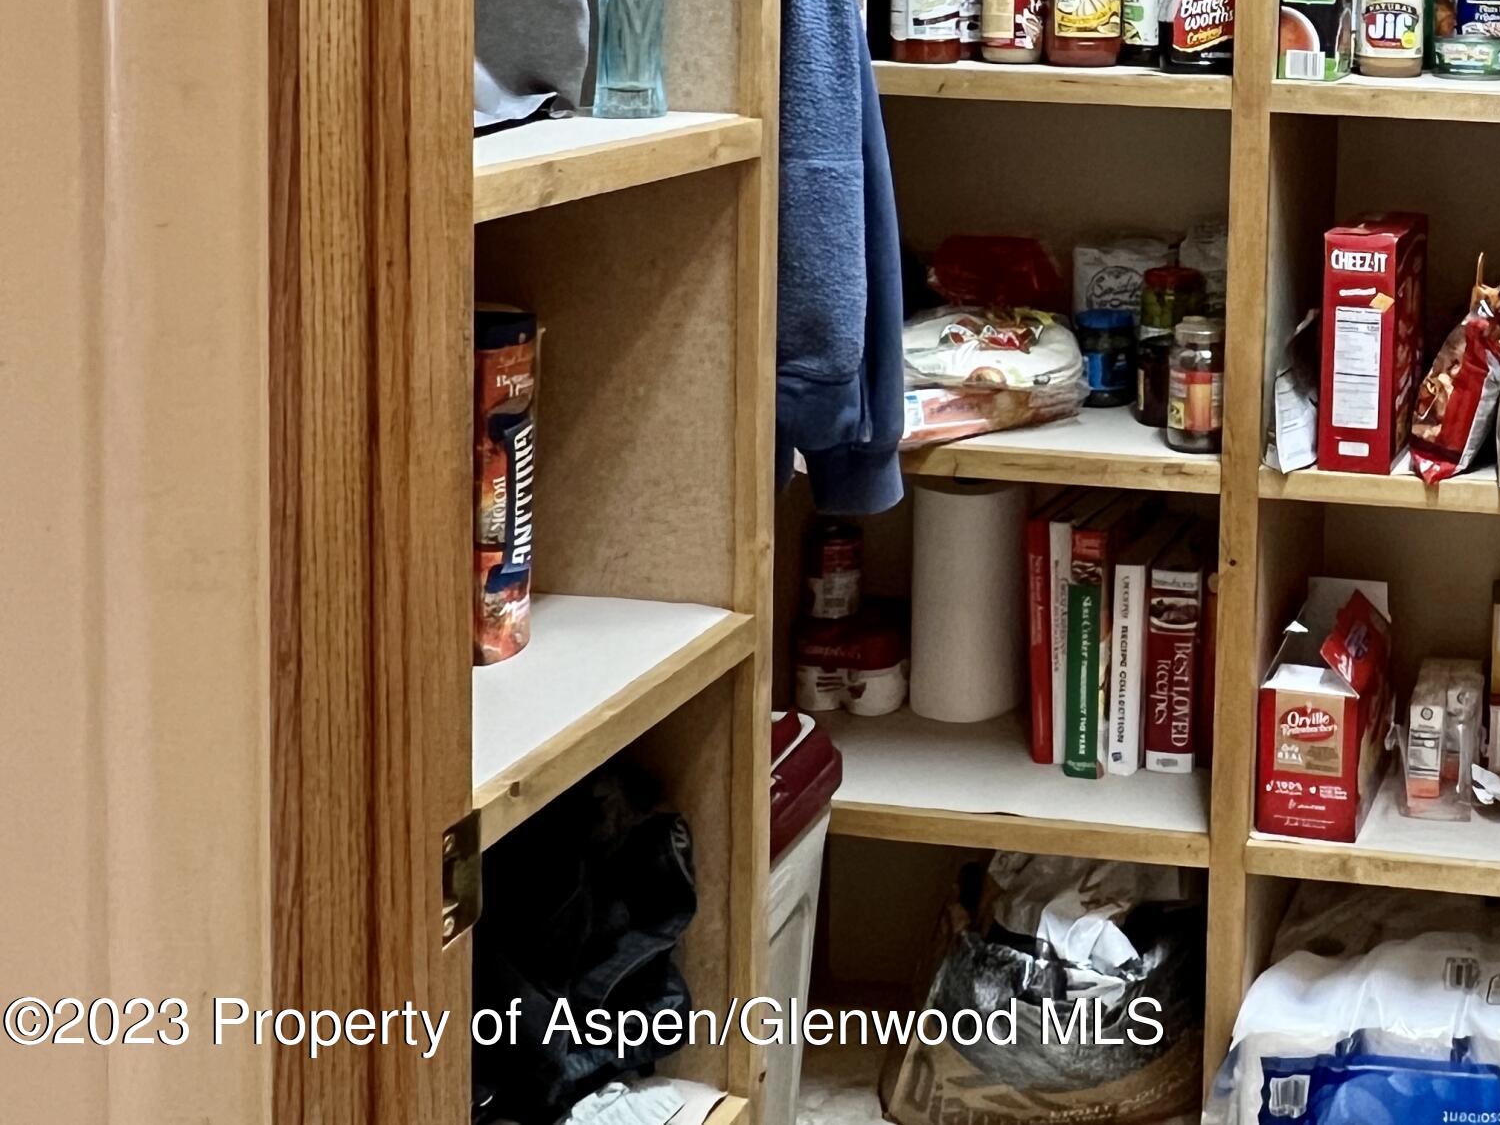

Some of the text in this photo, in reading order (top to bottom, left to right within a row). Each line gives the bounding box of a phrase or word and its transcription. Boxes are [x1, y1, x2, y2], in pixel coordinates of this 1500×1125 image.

[491, 476, 507, 531] BOOK
[1116, 671, 1128, 744] COLLECTION
[1170, 685, 1192, 747] LOVED
[1287, 711, 1330, 727] Orville
